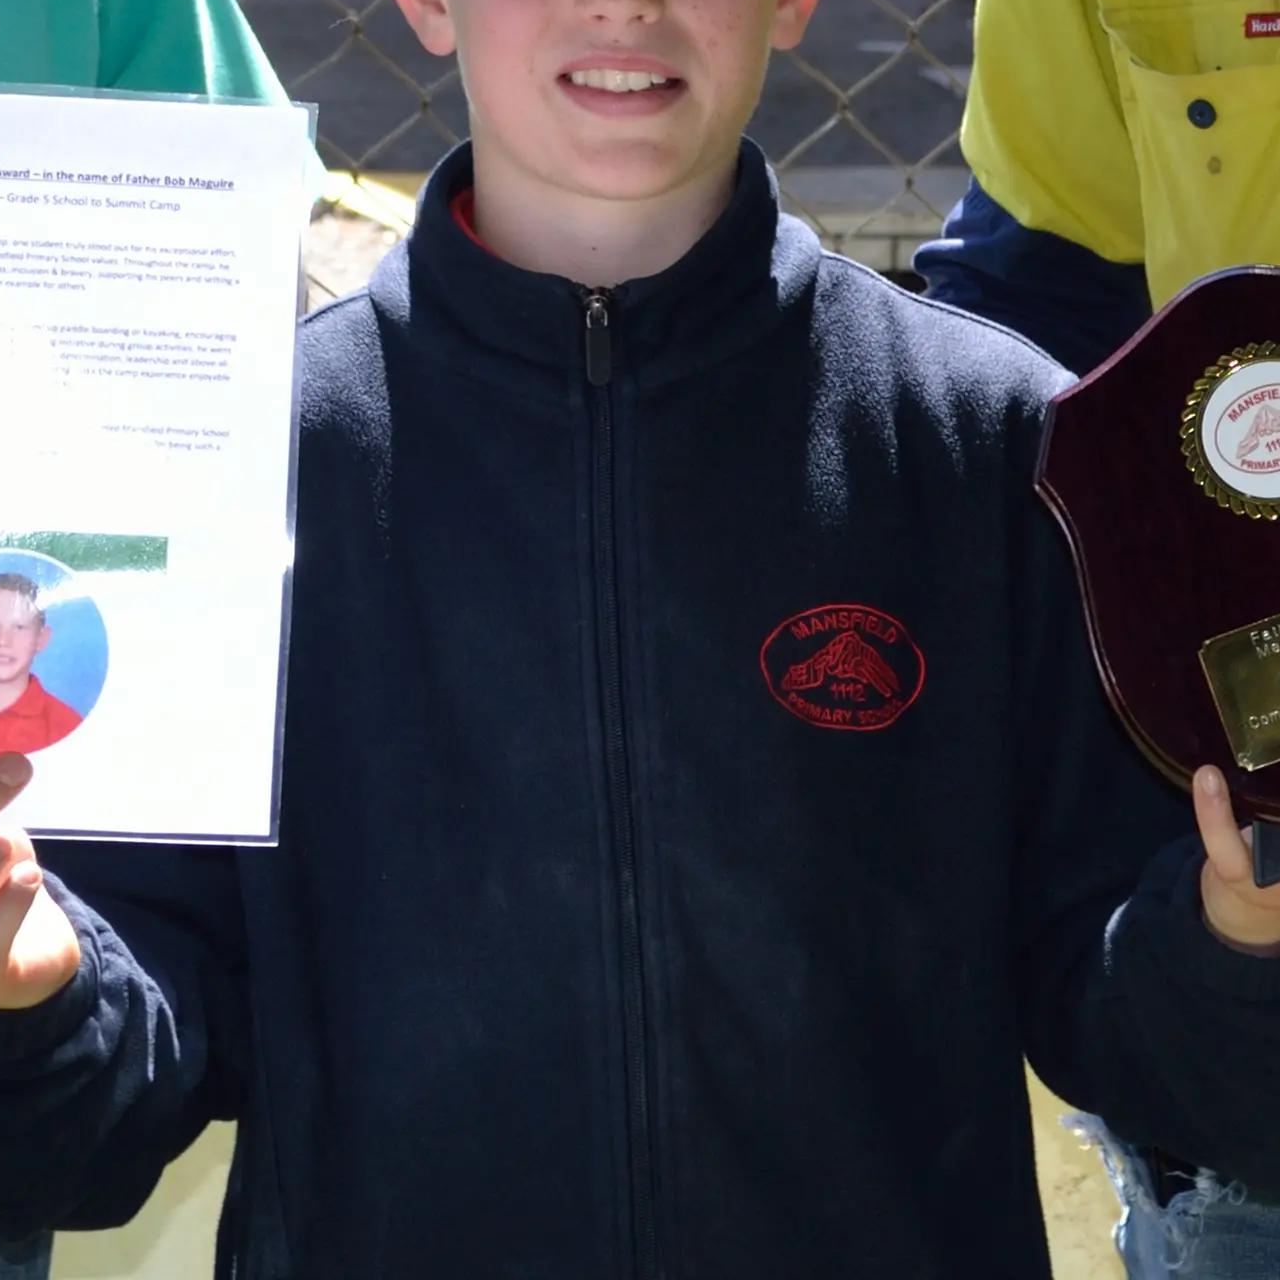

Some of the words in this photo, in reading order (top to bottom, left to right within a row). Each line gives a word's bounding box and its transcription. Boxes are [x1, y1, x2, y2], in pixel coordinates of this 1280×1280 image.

[1251, 18, 1280, 33] Hard
[43, 169, 53, 180] in
[56, 170, 75, 181] the
[77, 173, 109, 183] name
[111, 173, 123, 184] of
[126, 173, 161, 185] Father
[164, 176, 186, 187] Bob
[188, 178, 235, 191] Maguire
[6, 193, 40, 205] Grade
[43, 194, 50, 204] 5
[52, 194, 89, 207] School
[91, 197, 102, 208] to
[105, 197, 147, 209] Summit
[149, 200, 181, 212] Camp
[790, 611, 898, 644] MANSFIELD
[830, 683, 866, 703] 1112
[787, 692, 853, 723] PRIMARY
